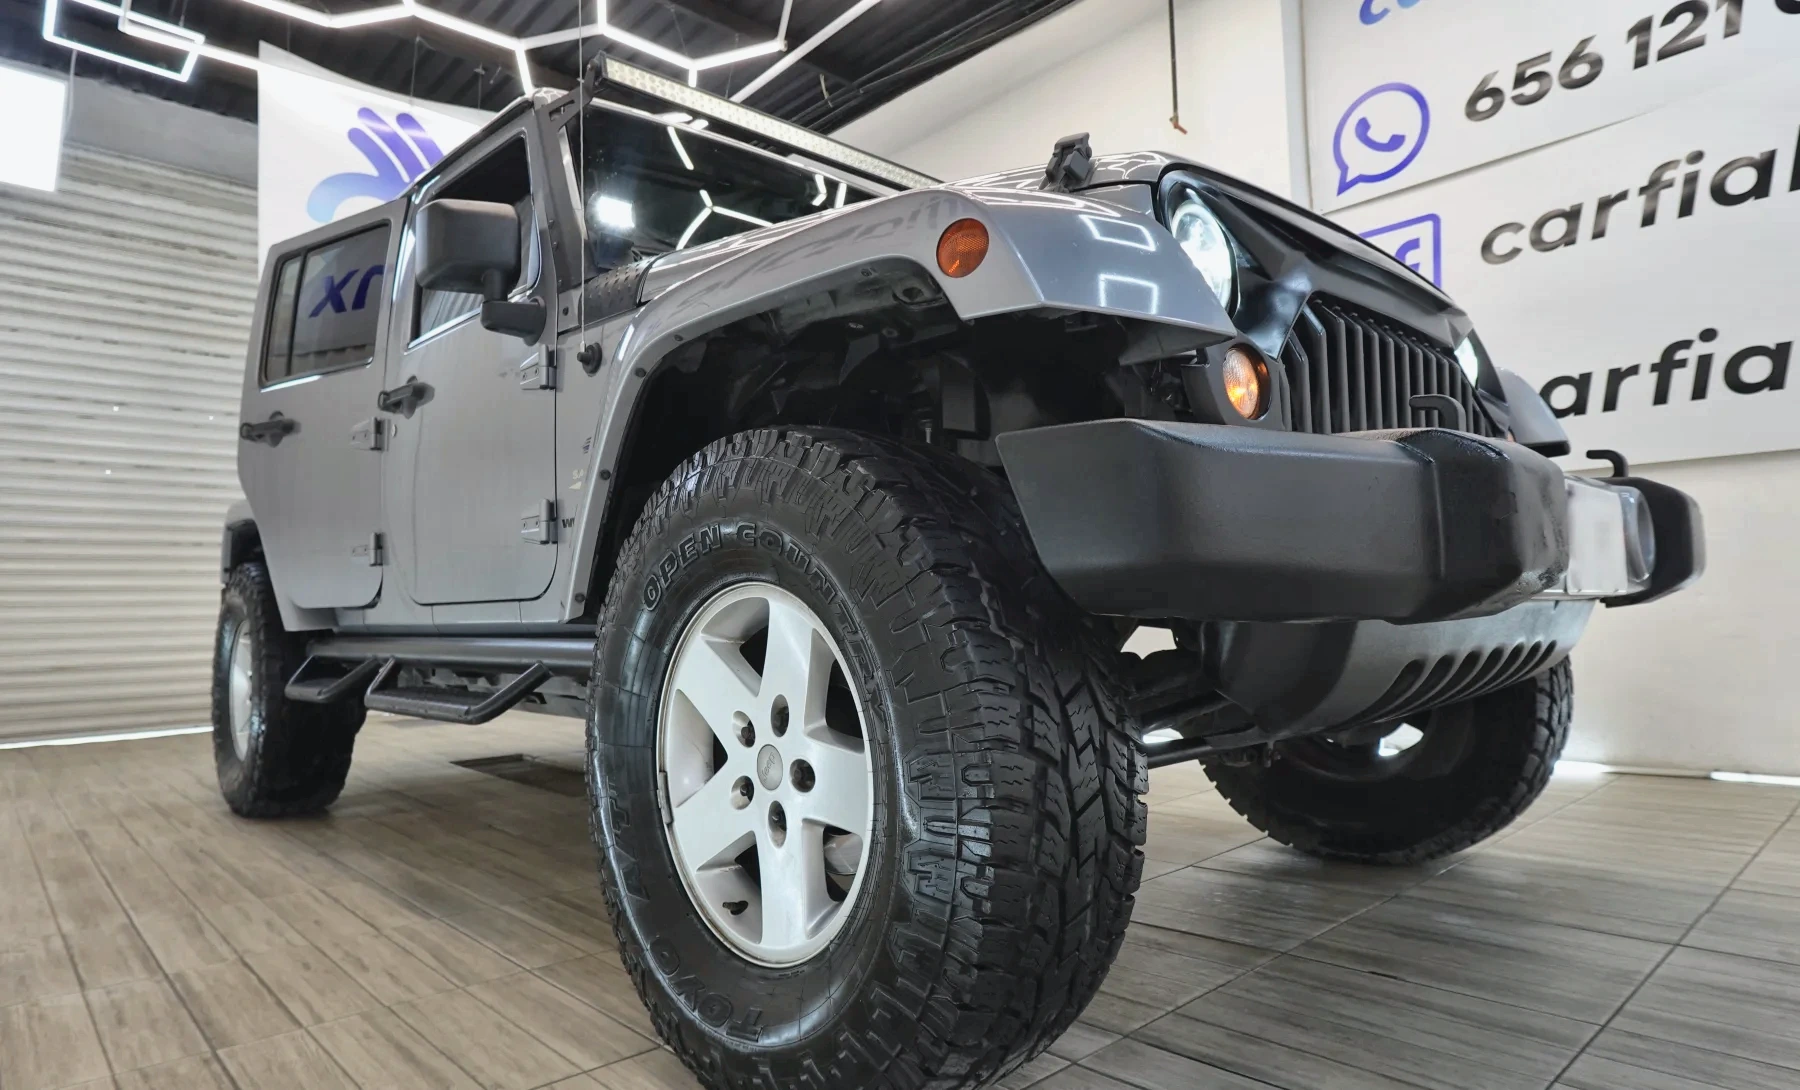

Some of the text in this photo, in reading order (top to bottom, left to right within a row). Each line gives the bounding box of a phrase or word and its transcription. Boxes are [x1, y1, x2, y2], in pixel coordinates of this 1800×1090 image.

[1464, 0, 1743, 122] 656 121
[1539, 328, 1793, 419] arfia
[642, 522, 723, 611] OPEN
[648, 937, 764, 1043] TOYO
